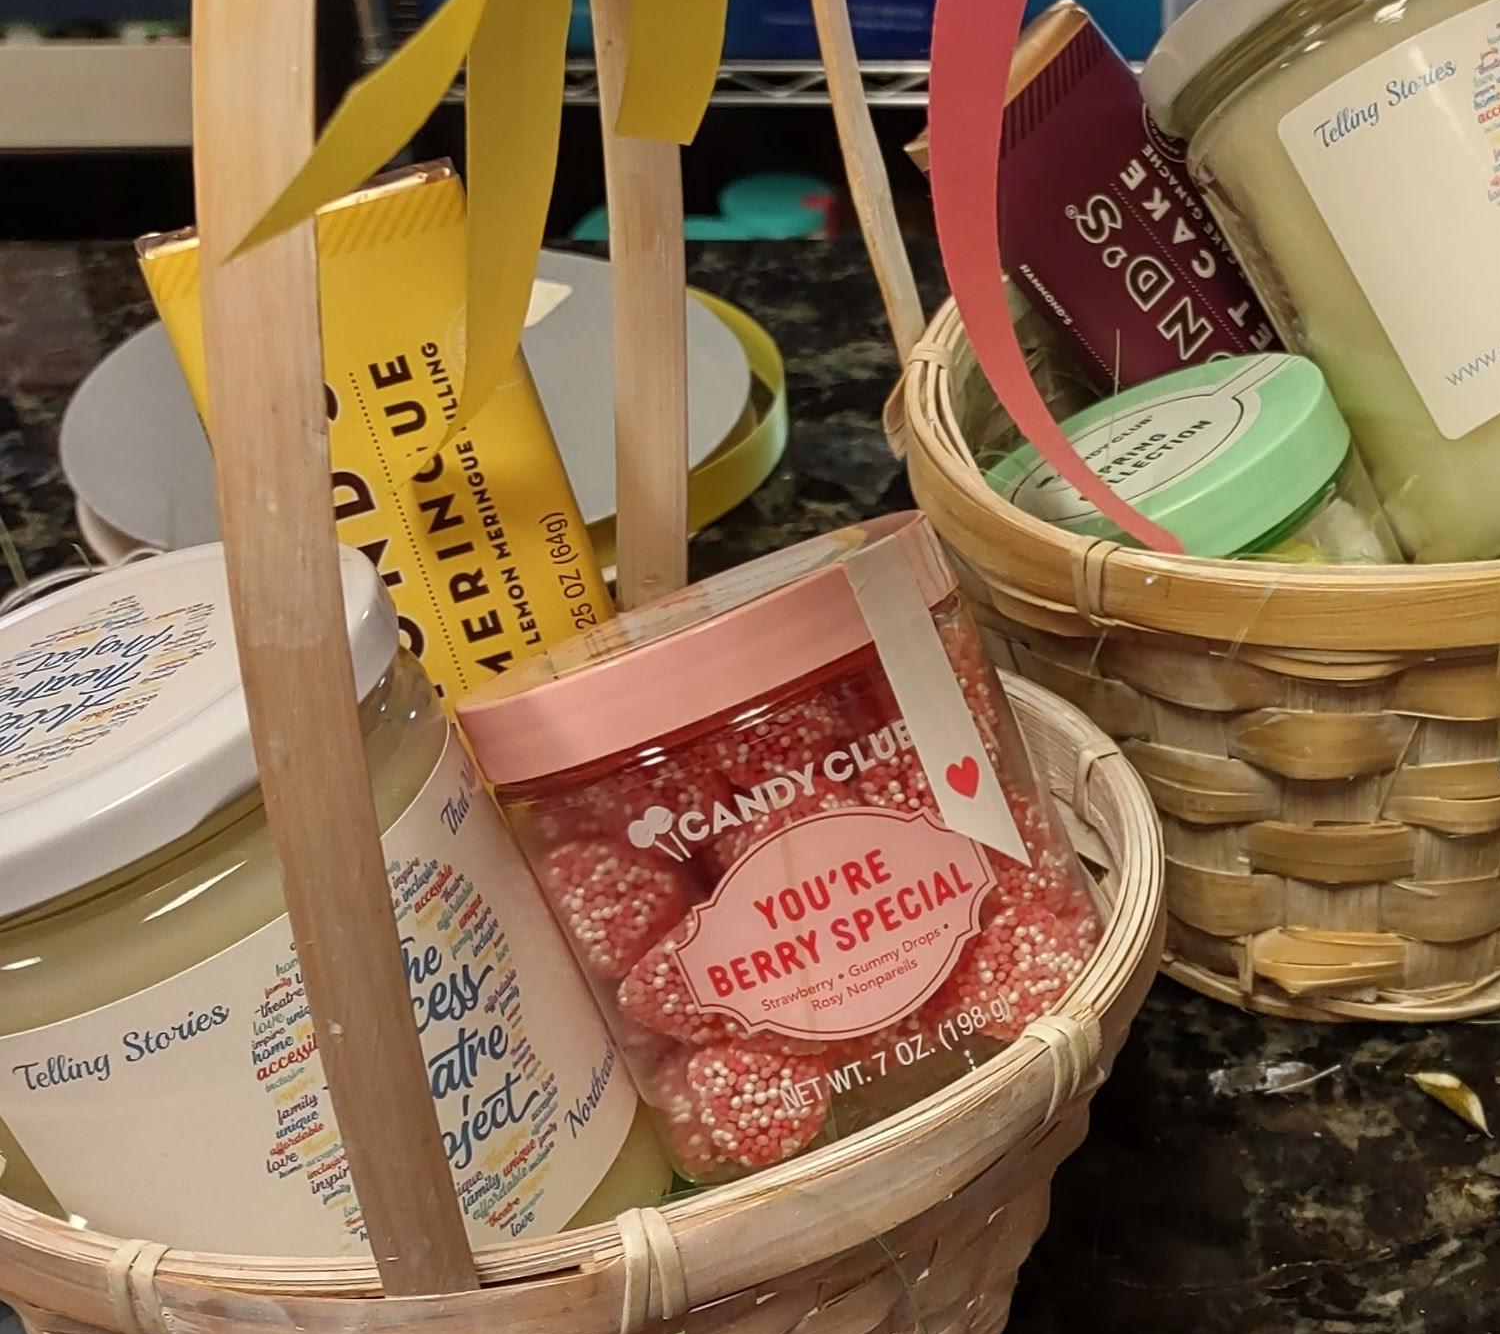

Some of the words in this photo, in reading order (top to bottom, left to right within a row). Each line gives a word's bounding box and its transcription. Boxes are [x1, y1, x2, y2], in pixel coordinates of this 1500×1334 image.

[1312, 99, 1380, 151] Telling
[1385, 60, 1459, 110] Stories
[1141, 142, 1204, 221] GANACHE
[1119, 158, 1217, 279] CAKE
[1019, 264, 1074, 326] HAMMOND'S
[421, 341, 462, 426] ILLING
[1092, 419, 1213, 491] LLECTION
[1097, 432, 1168, 478] PRING
[456, 440, 512, 560] MERINGUE
[538, 511, 580, 565] (64g)
[502, 566, 542, 645] LEMON
[559, 569, 585, 599] OZ
[15, 624, 175, 680] Project
[678, 761, 816, 842] CANDY
[822, 717, 915, 783] CLUB
[753, 847, 892, 931] YOU'RE
[400, 936, 442, 984] he
[706, 927, 821, 999] BERRY
[830, 862, 974, 952] SPECIAL
[412, 964, 494, 1035] cess
[761, 976, 835, 1013] Strawberry
[848, 947, 900, 978] Gummy
[901, 926, 942, 954] Drops
[812, 993, 844, 1014] Rosy
[846, 957, 919, 999] Nonpareils
[15, 1045, 112, 1094] Telling
[122, 1002, 231, 1062] Stories
[252, 1036, 294, 1065] home
[428, 1017, 508, 1100] atre
[779, 1076, 825, 1112] NET
[825, 1060, 873, 1095] WT.
[870, 1051, 888, 1077] 7
[894, 1033, 936, 1067] OZ.
[938, 1005, 988, 1051] (198
[990, 991, 1012, 1023] g)
[270, 1123, 325, 1156] affordable
[276, 1111, 319, 1139] unique
[277, 1094, 318, 1125] family
[441, 1071, 541, 1170] oject
[266, 1152, 299, 1174] love
[311, 1166, 351, 1195] inspir
[462, 1173, 501, 1216] family
[510, 1210, 536, 1237] love
